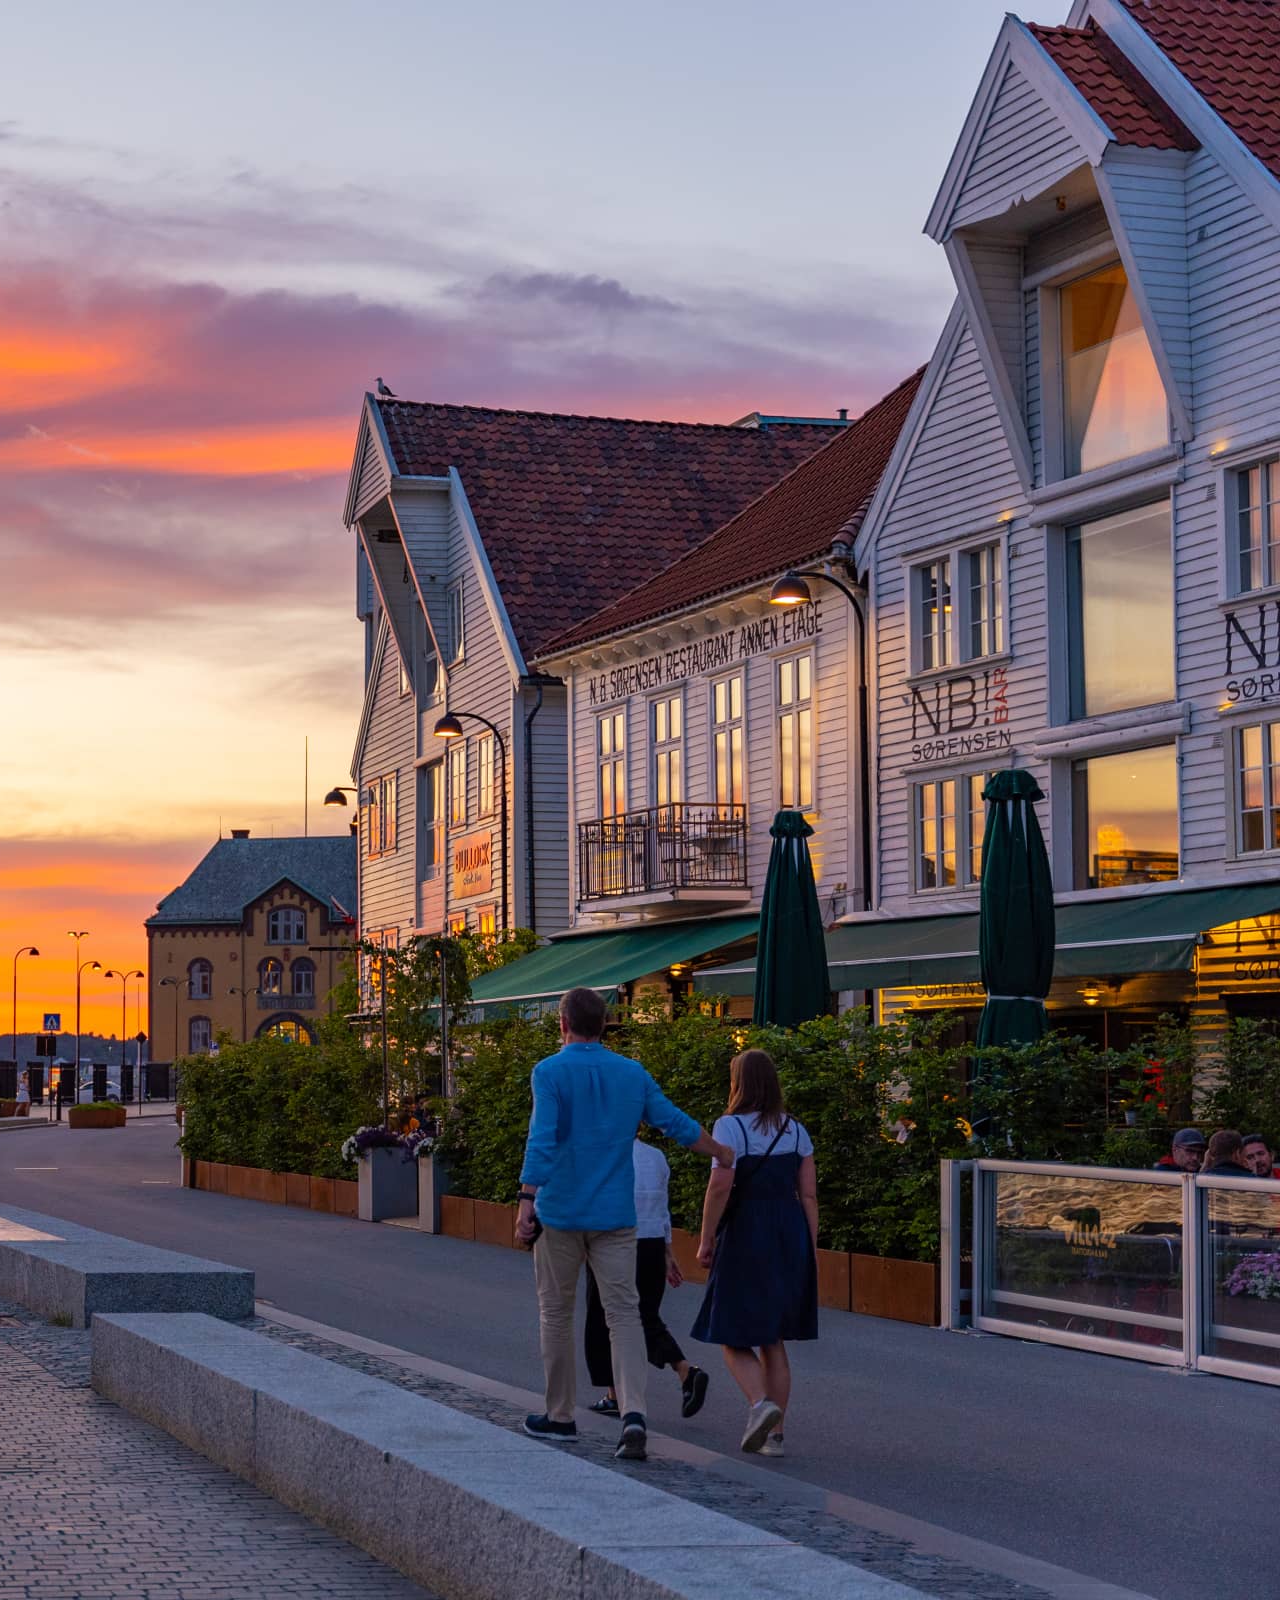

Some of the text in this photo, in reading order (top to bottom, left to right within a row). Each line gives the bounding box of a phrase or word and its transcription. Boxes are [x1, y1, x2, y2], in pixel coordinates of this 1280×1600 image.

[666, 633, 734, 682] RESTAURANT
[739, 615, 778, 658] ANNEN
[783, 600, 823, 645] ETAGE
[1224, 602, 1280, 675] N
[994, 668, 1009, 723] BAR
[1226, 674, 1280, 701] SØR
[912, 728, 1012, 761] SØRENSEN
[455, 842, 489, 873] BULLOCK
